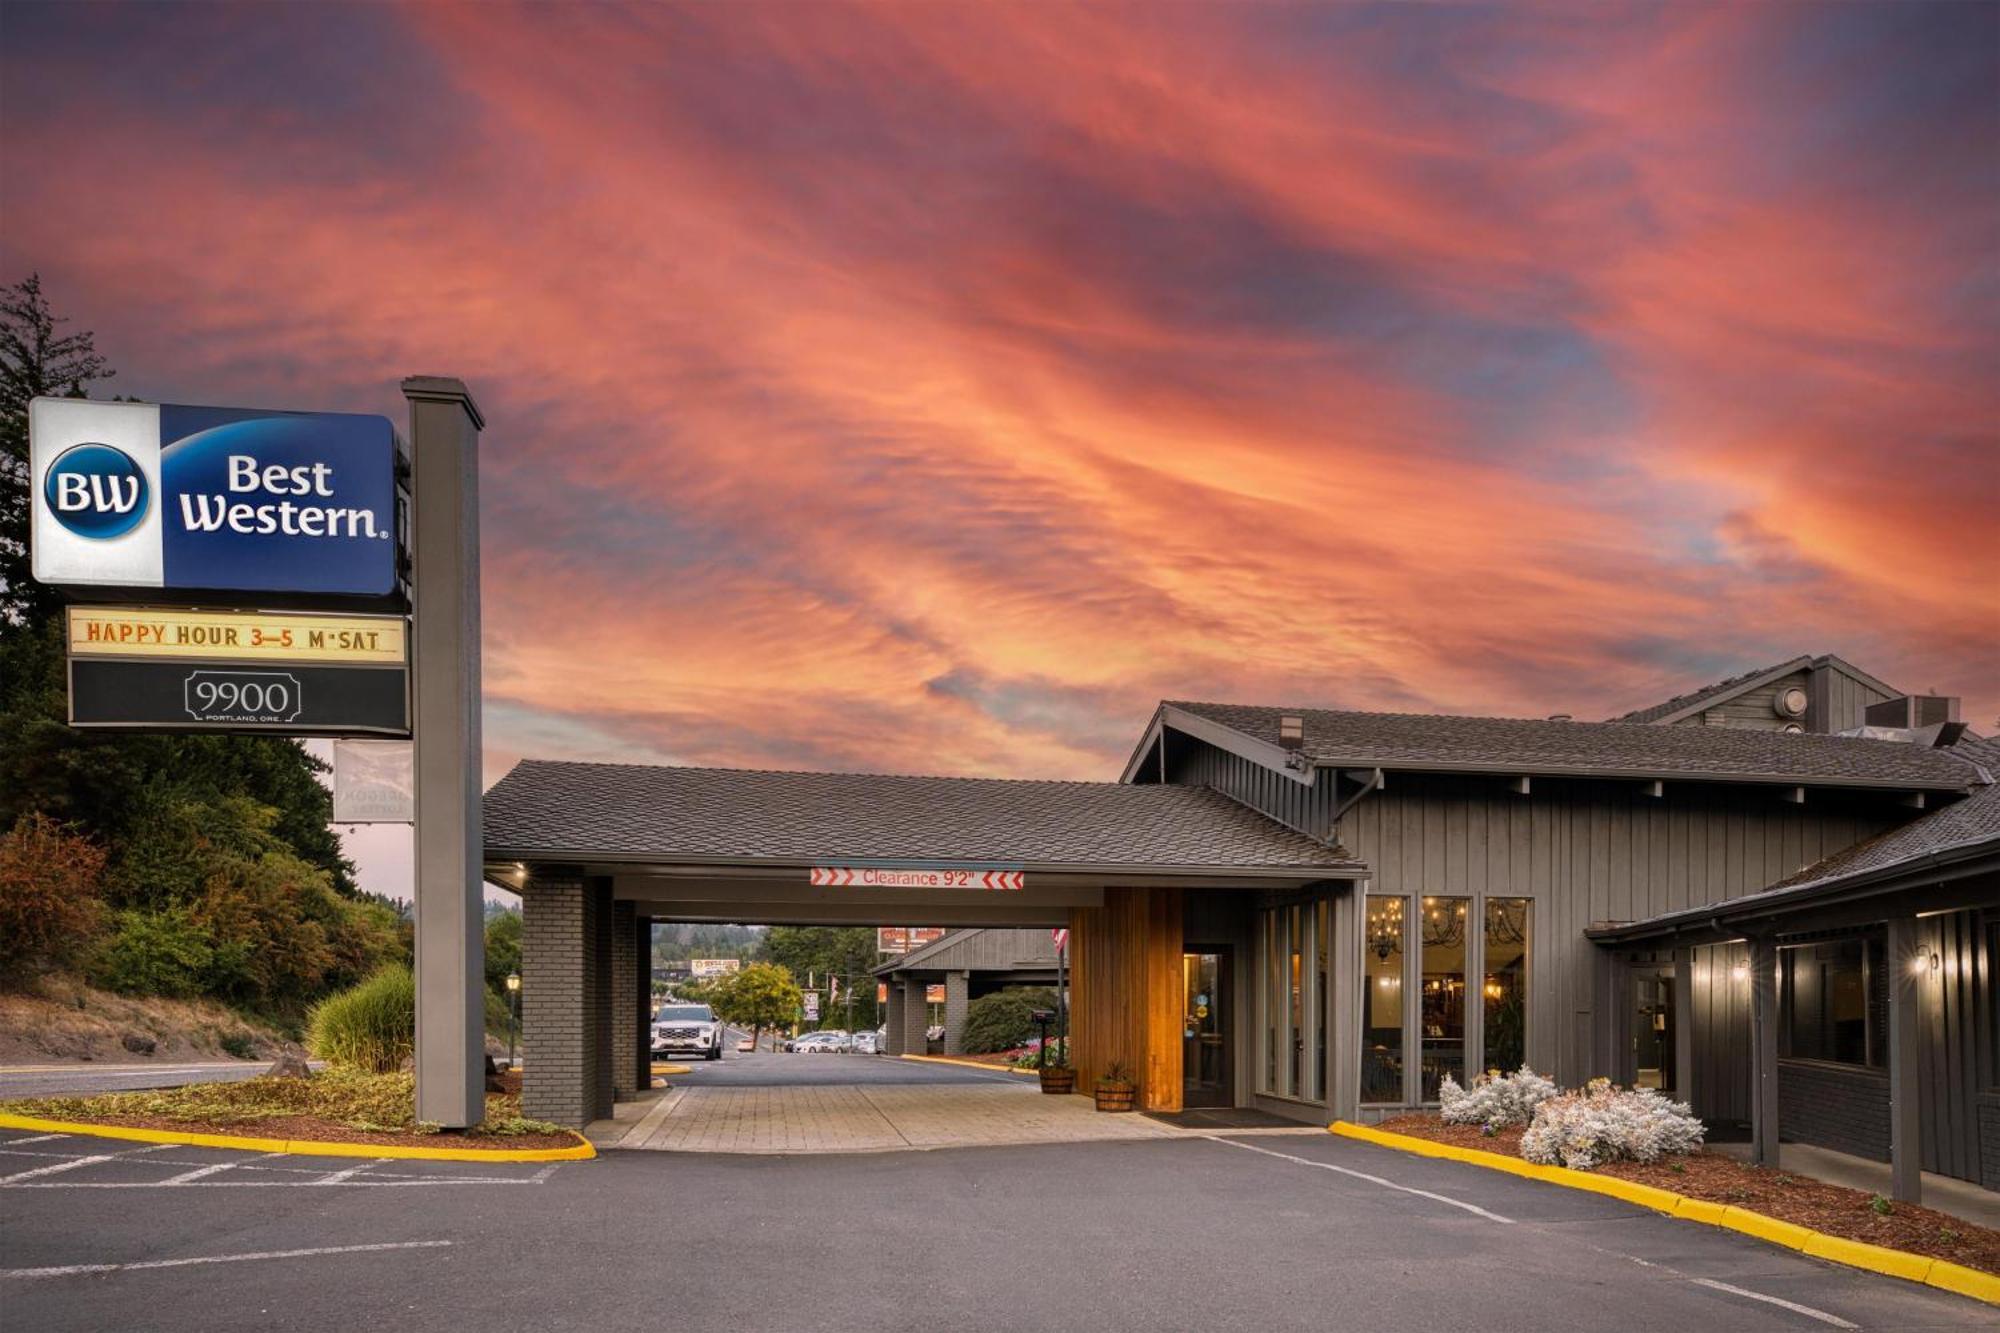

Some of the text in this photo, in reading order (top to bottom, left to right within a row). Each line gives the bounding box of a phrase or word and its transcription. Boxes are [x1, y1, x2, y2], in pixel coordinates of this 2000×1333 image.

[57, 472, 139, 513] BW
[228, 455, 334, 496] Best
[179, 493, 377, 538] Western
[87, 621, 166, 643] HAPPY
[176, 625, 238, 646] HOUR
[196, 681, 289, 713] 9900
[863, 869, 938, 885] Clearance
